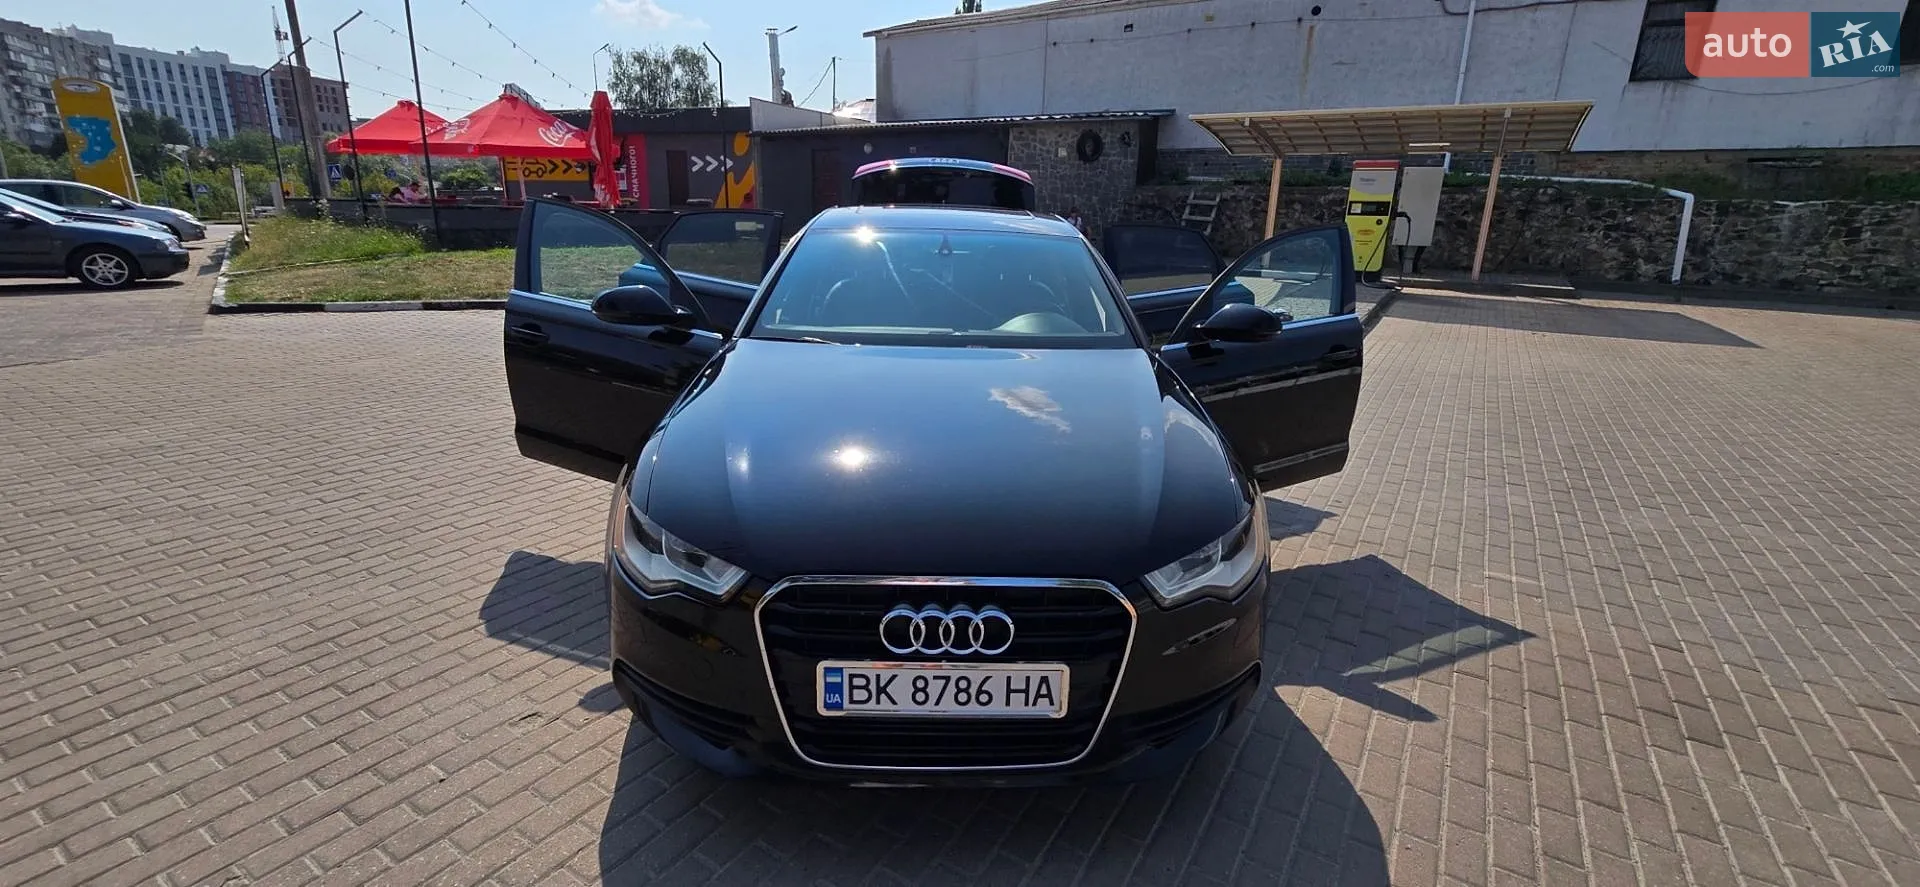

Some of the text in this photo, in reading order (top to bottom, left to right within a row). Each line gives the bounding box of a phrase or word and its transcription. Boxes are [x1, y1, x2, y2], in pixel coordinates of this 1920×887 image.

[826, 693, 841, 704] UA
[848, 673, 1055, 707] BK 8786 HA
